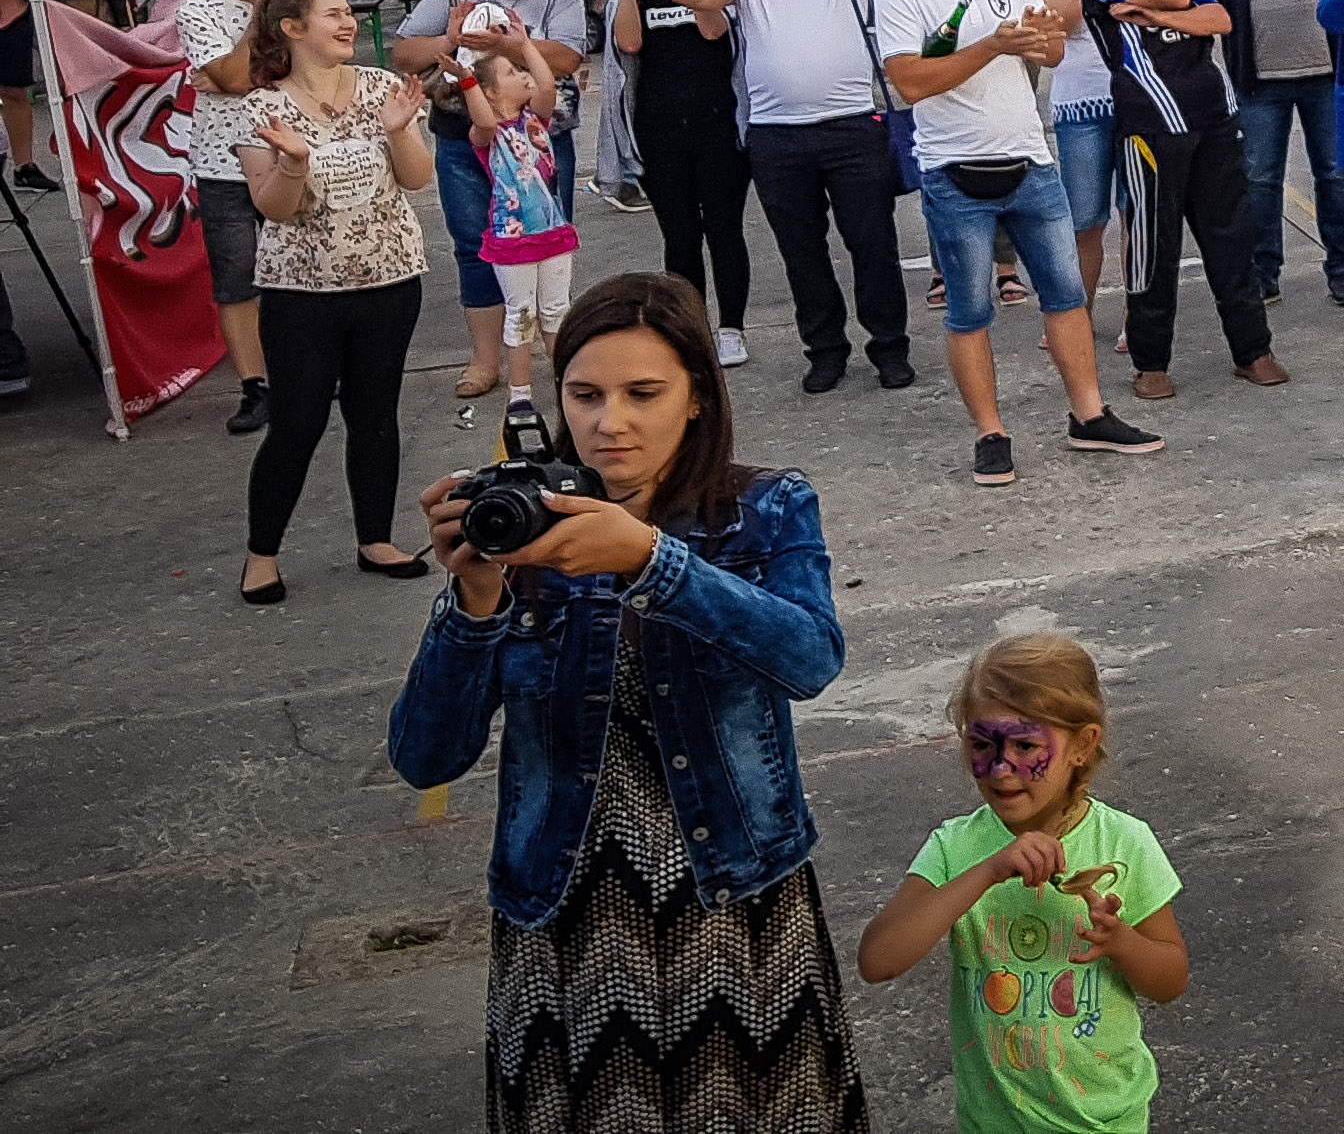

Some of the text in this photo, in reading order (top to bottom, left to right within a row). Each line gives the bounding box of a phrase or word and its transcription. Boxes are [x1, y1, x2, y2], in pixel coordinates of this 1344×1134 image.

[981, 913, 1092, 964] ALOHA
[960, 966, 1101, 1019] TROPICAL
[987, 1023, 1067, 1073] VIBES
